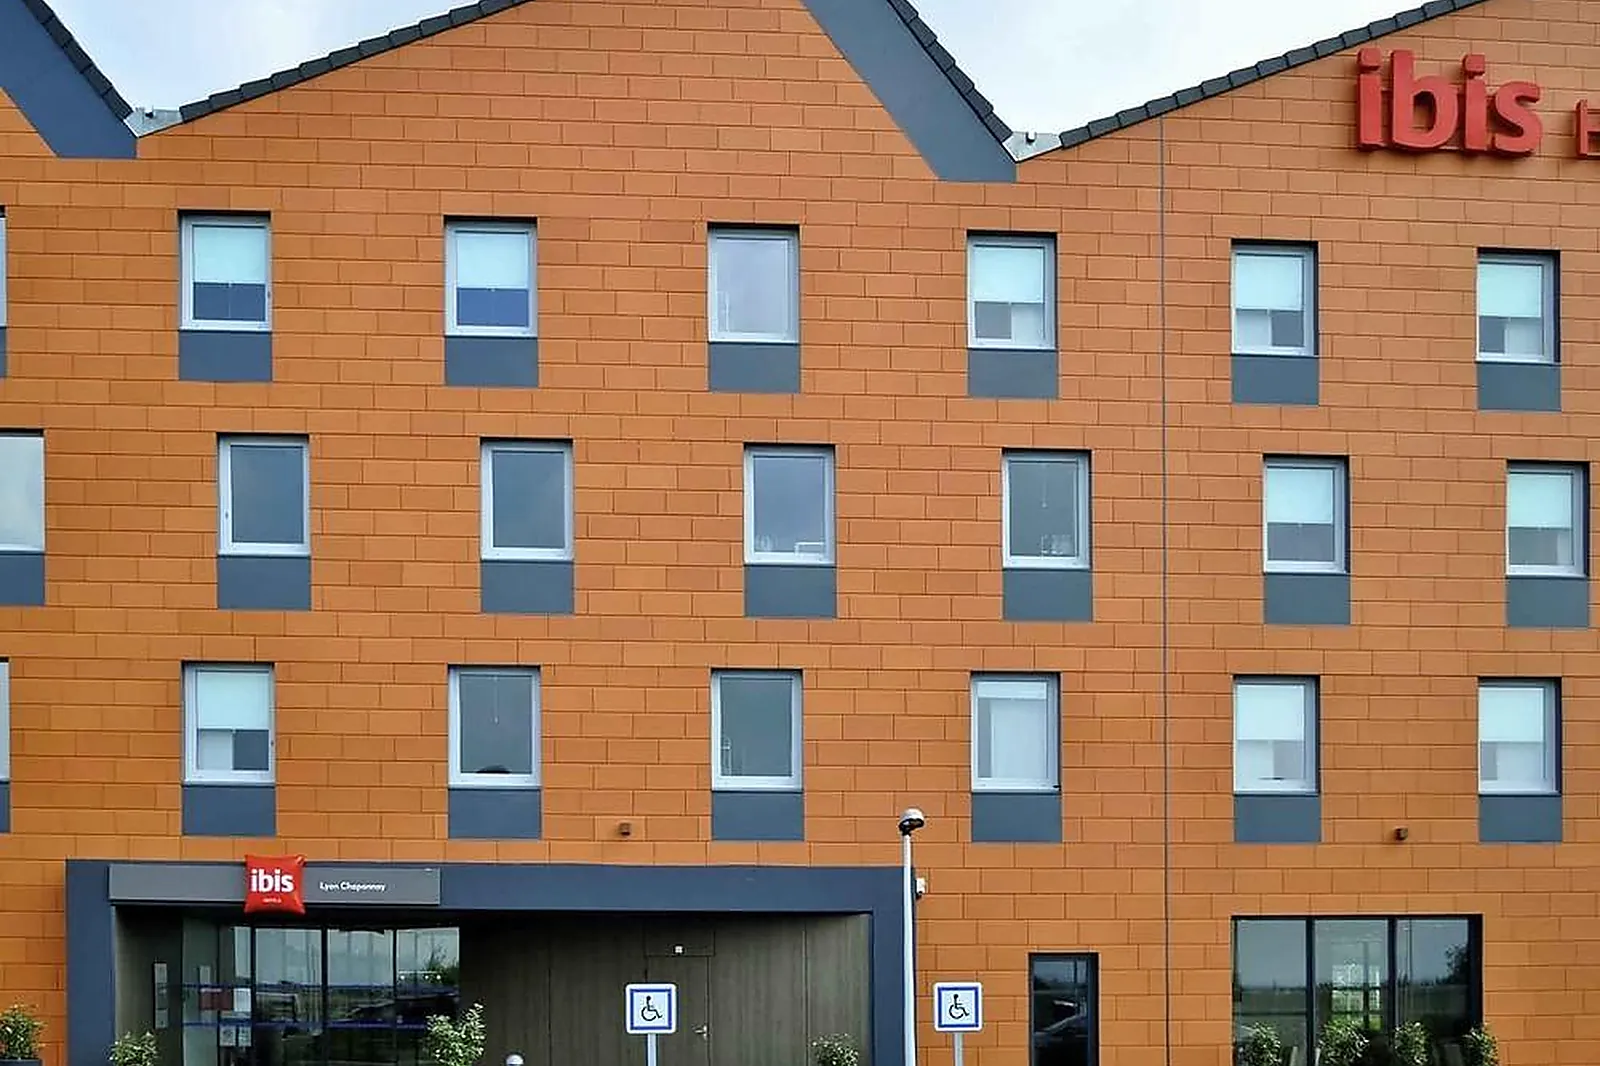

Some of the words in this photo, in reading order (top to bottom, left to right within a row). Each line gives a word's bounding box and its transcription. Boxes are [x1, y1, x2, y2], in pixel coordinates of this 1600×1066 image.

[1357, 48, 1542, 154] ibis
[251, 868, 295, 892] ibis
[319, 881, 340, 891] Lyon
